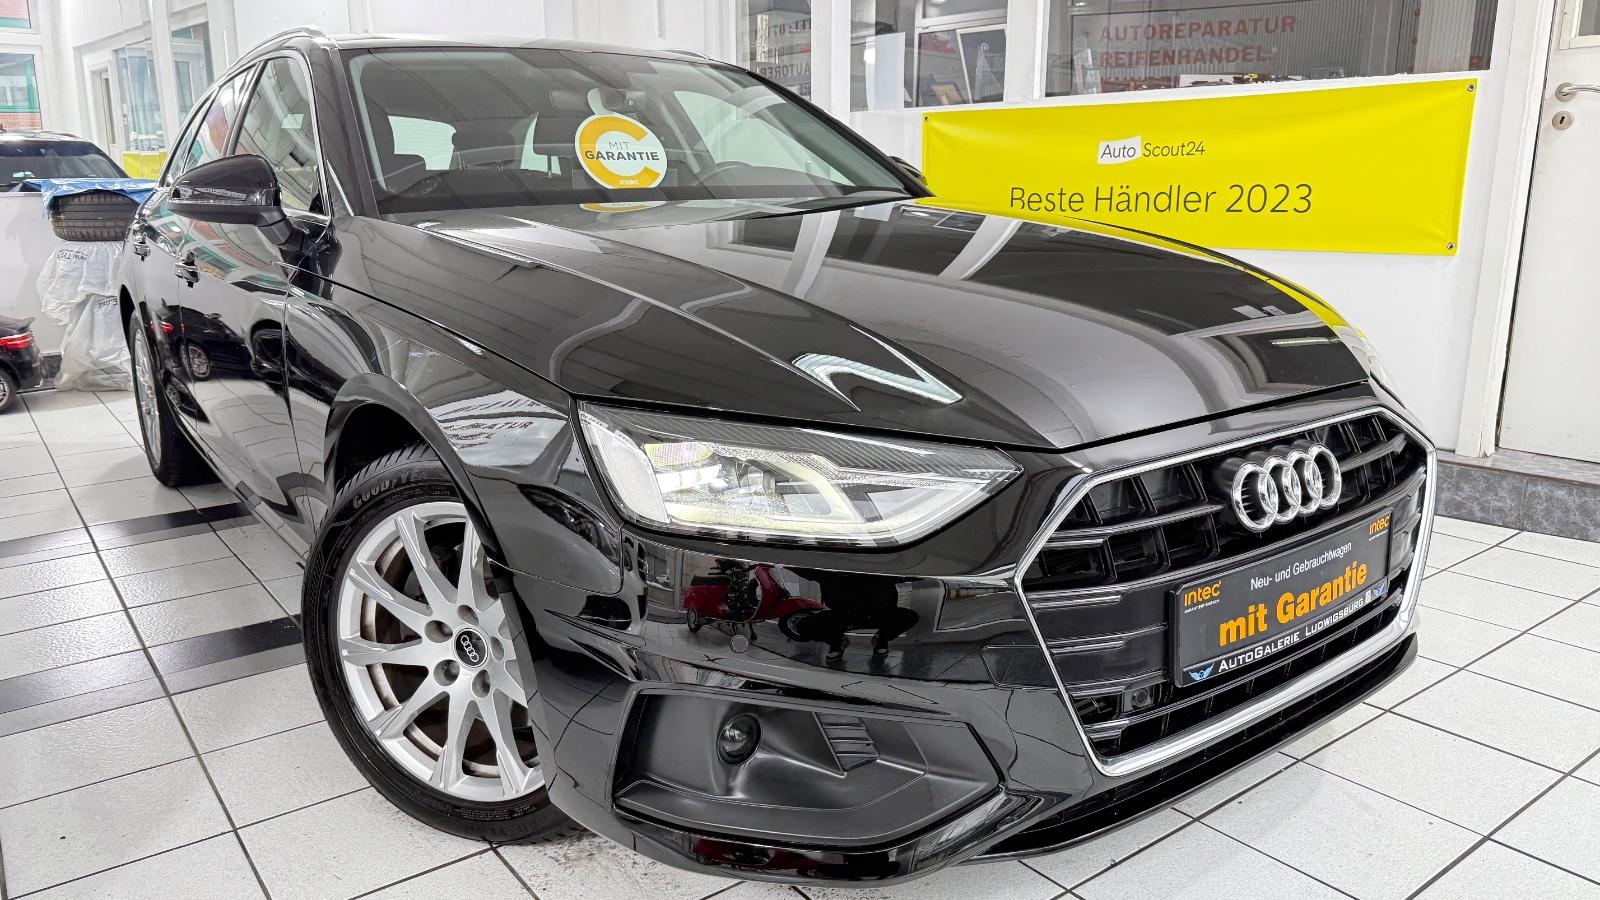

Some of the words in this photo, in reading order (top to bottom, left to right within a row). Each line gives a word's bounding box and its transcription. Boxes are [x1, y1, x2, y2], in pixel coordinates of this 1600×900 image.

[1099, 16, 1297, 42] AUTOREPARATUR
[584, 150, 660, 161] GARANTIE
[608, 141, 630, 151] MIT
[1100, 143, 1136, 160] Auto
[1143, 140, 1206, 157] Scout24
[1010, 187, 1085, 212] Beste
[1094, 184, 1217, 213] Händler
[1225, 183, 1313, 213] 2023
[1250, 577, 1273, 591] Neu-
[1275, 565, 1291, 583] und
[1293, 542, 1352, 576] Gebrauchtwagen
[1219, 603, 1268, 647] mit
[1276, 560, 1367, 624] Garantie
